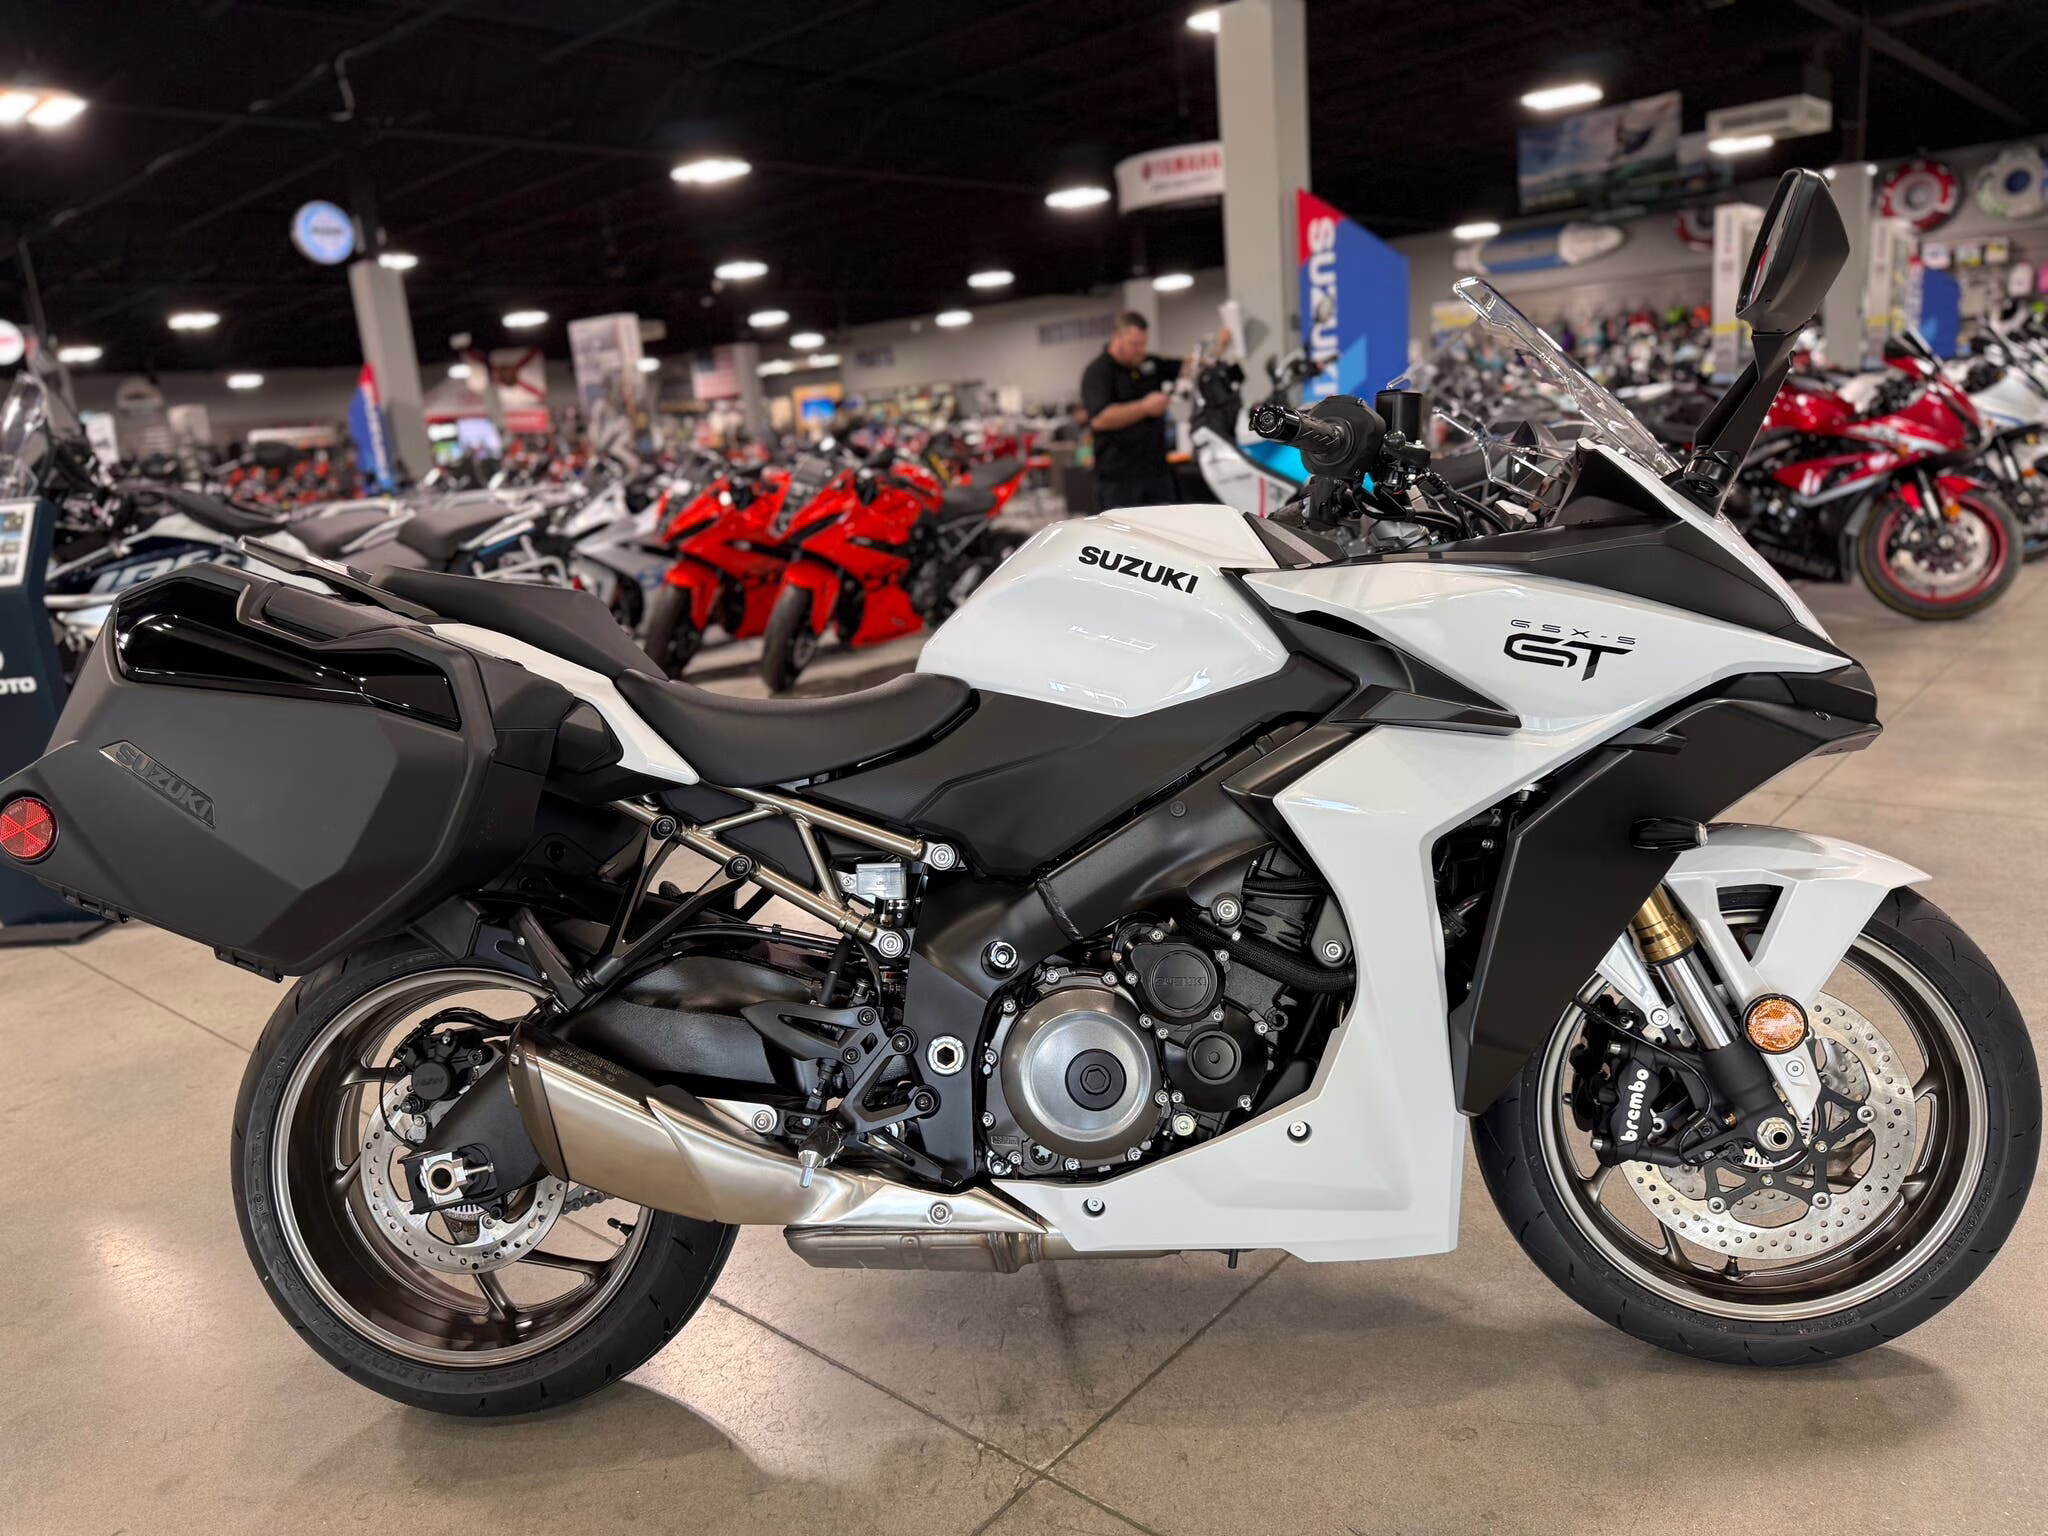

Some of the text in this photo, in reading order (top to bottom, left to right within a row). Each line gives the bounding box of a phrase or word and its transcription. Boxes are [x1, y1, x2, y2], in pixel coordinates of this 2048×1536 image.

[1078, 545, 1199, 594] SUZUKI
[1503, 632, 1633, 682] GT
[1510, 619, 1637, 646] GSX-S
[114, 742, 212, 819] SUZUKI
[1620, 1068, 1649, 1142] brembo
